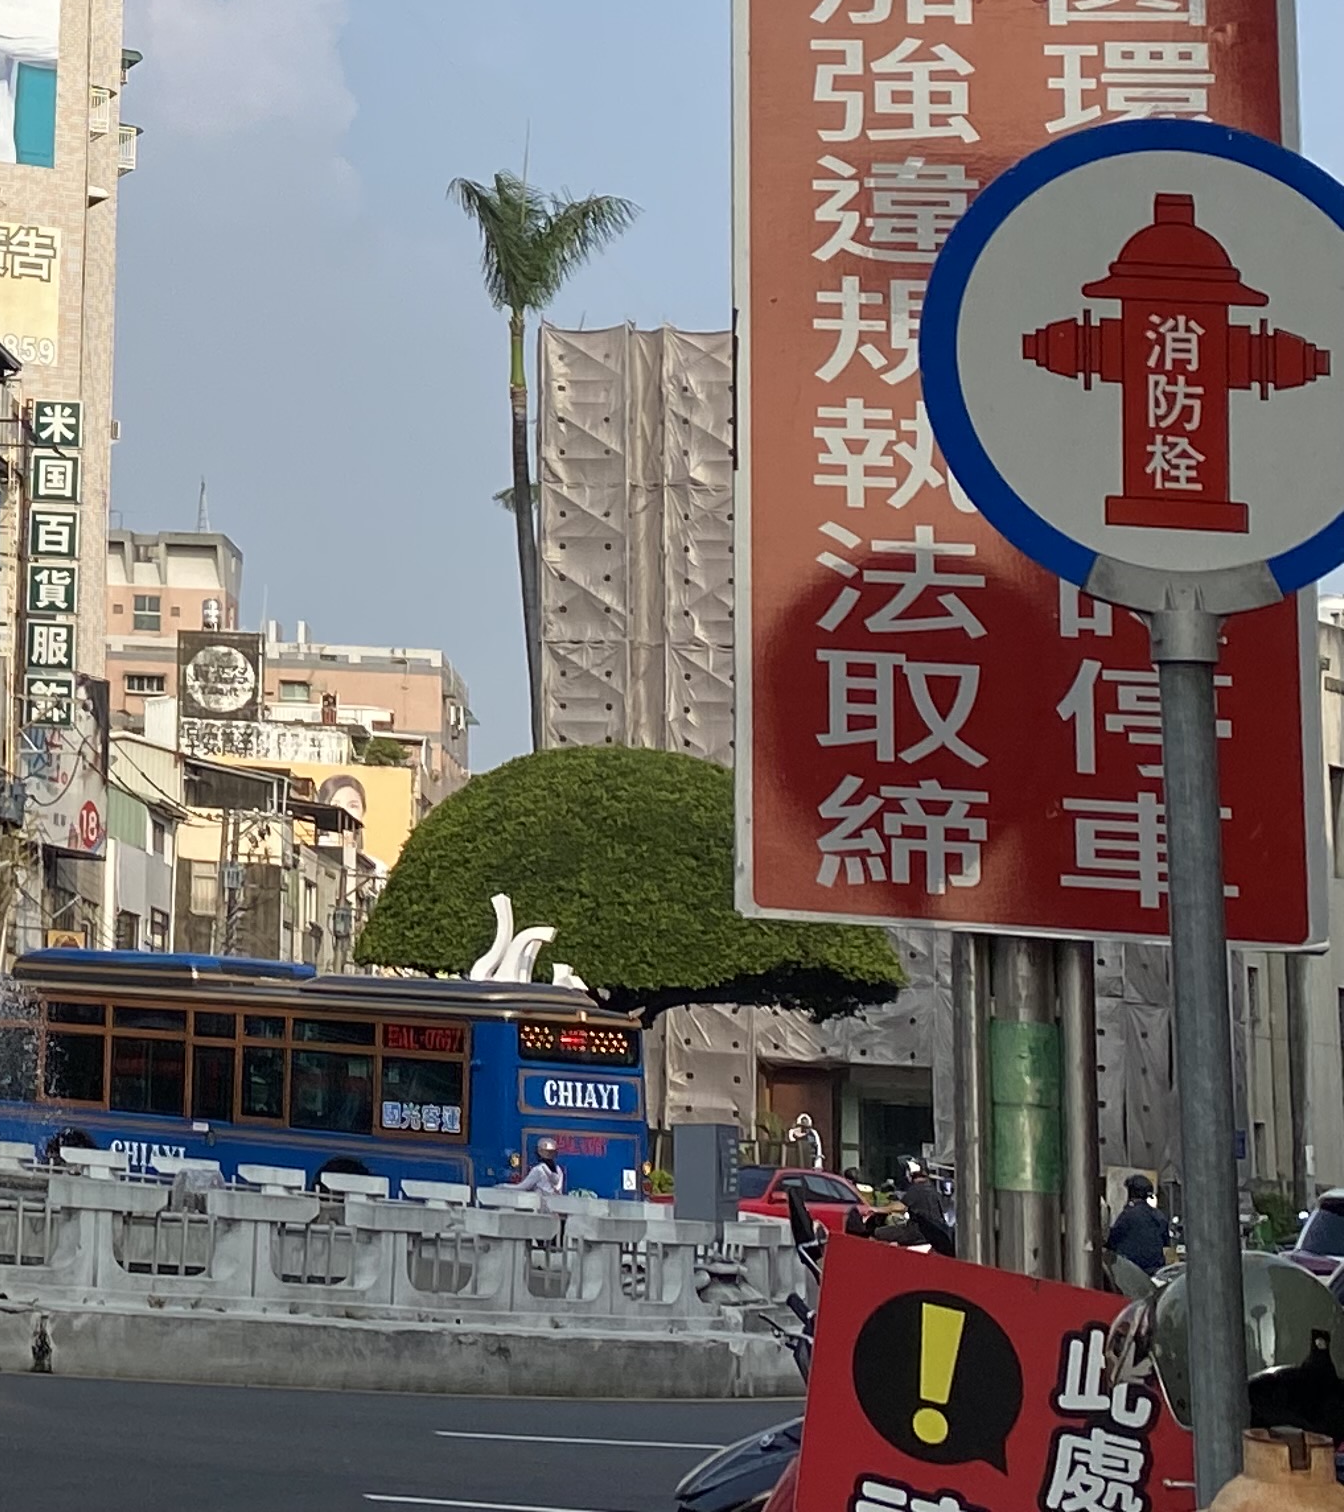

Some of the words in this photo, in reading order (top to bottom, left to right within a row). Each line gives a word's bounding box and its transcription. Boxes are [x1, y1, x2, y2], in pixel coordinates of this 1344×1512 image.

[1144, 313, 1206, 492] 消防栓
[81, 809, 98, 842] 18
[543, 1079, 620, 1110] CHIAYI
